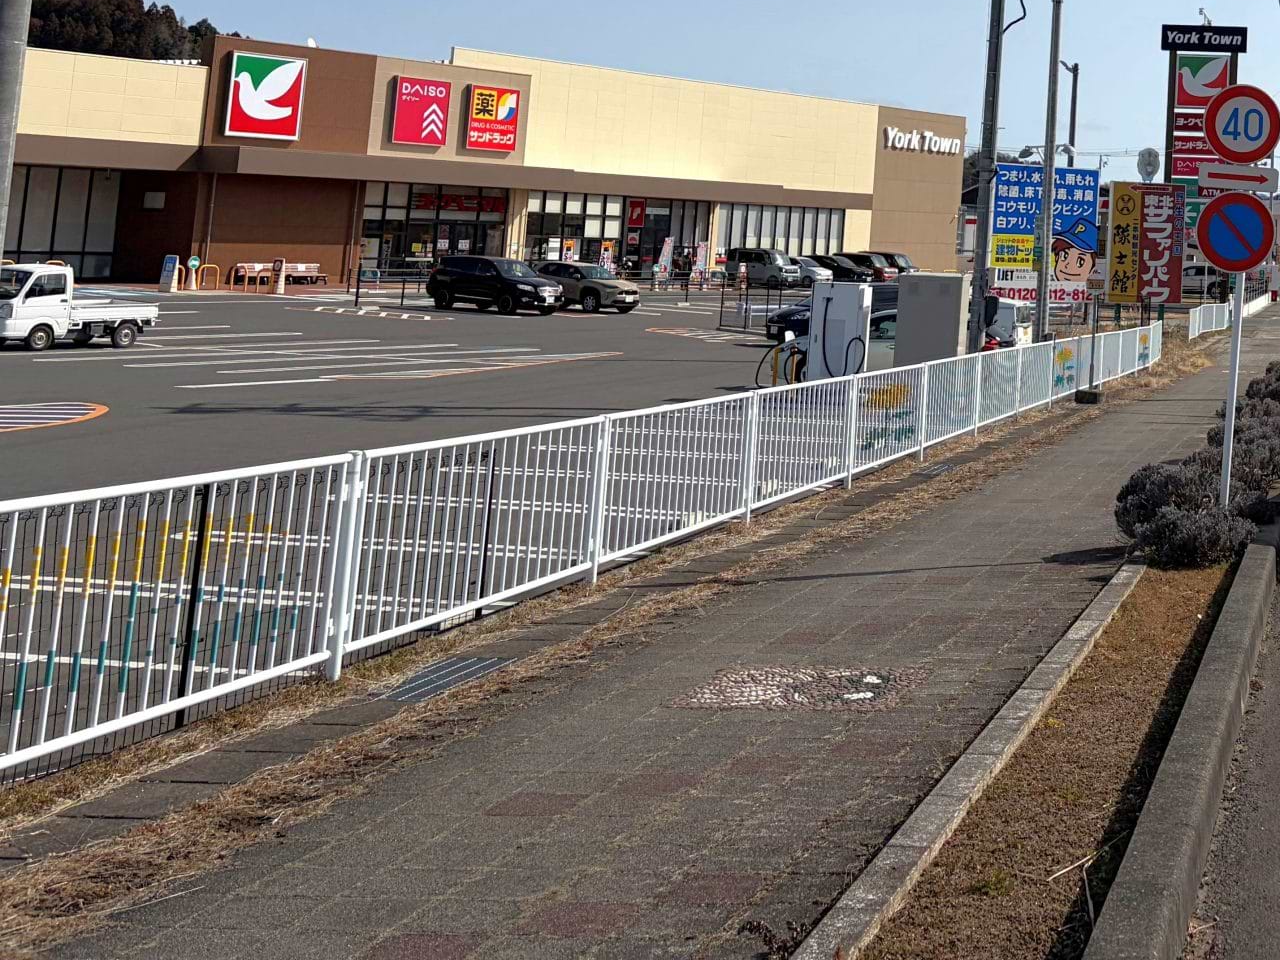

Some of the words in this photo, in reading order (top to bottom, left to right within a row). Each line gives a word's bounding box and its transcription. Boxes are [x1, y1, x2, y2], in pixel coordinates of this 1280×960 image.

[1167, 31, 1199, 44] York
[1202, 32, 1242, 46] Town
[402, 83, 446, 98] DAISO
[475, 91, 495, 117] 薬
[1176, 117, 1203, 127] ヨークベ
[1222, 107, 1264, 142] 40
[470, 131, 514, 145] サンドラッグ
[887, 126, 921, 150] York
[923, 130, 961, 154] Town
[1174, 141, 1210, 151] サンドラッ
[1000, 170, 1094, 186] つまり、水れ、雨もれ
[998, 186, 1093, 201] 除菌、床下毒、消臭
[1202, 188, 1220, 197] ATM
[997, 201, 1092, 216] コウモリ、クビシン
[997, 217, 1062, 231] 白アリ、ミ
[1007, 288, 1093, 302] 012012-812
